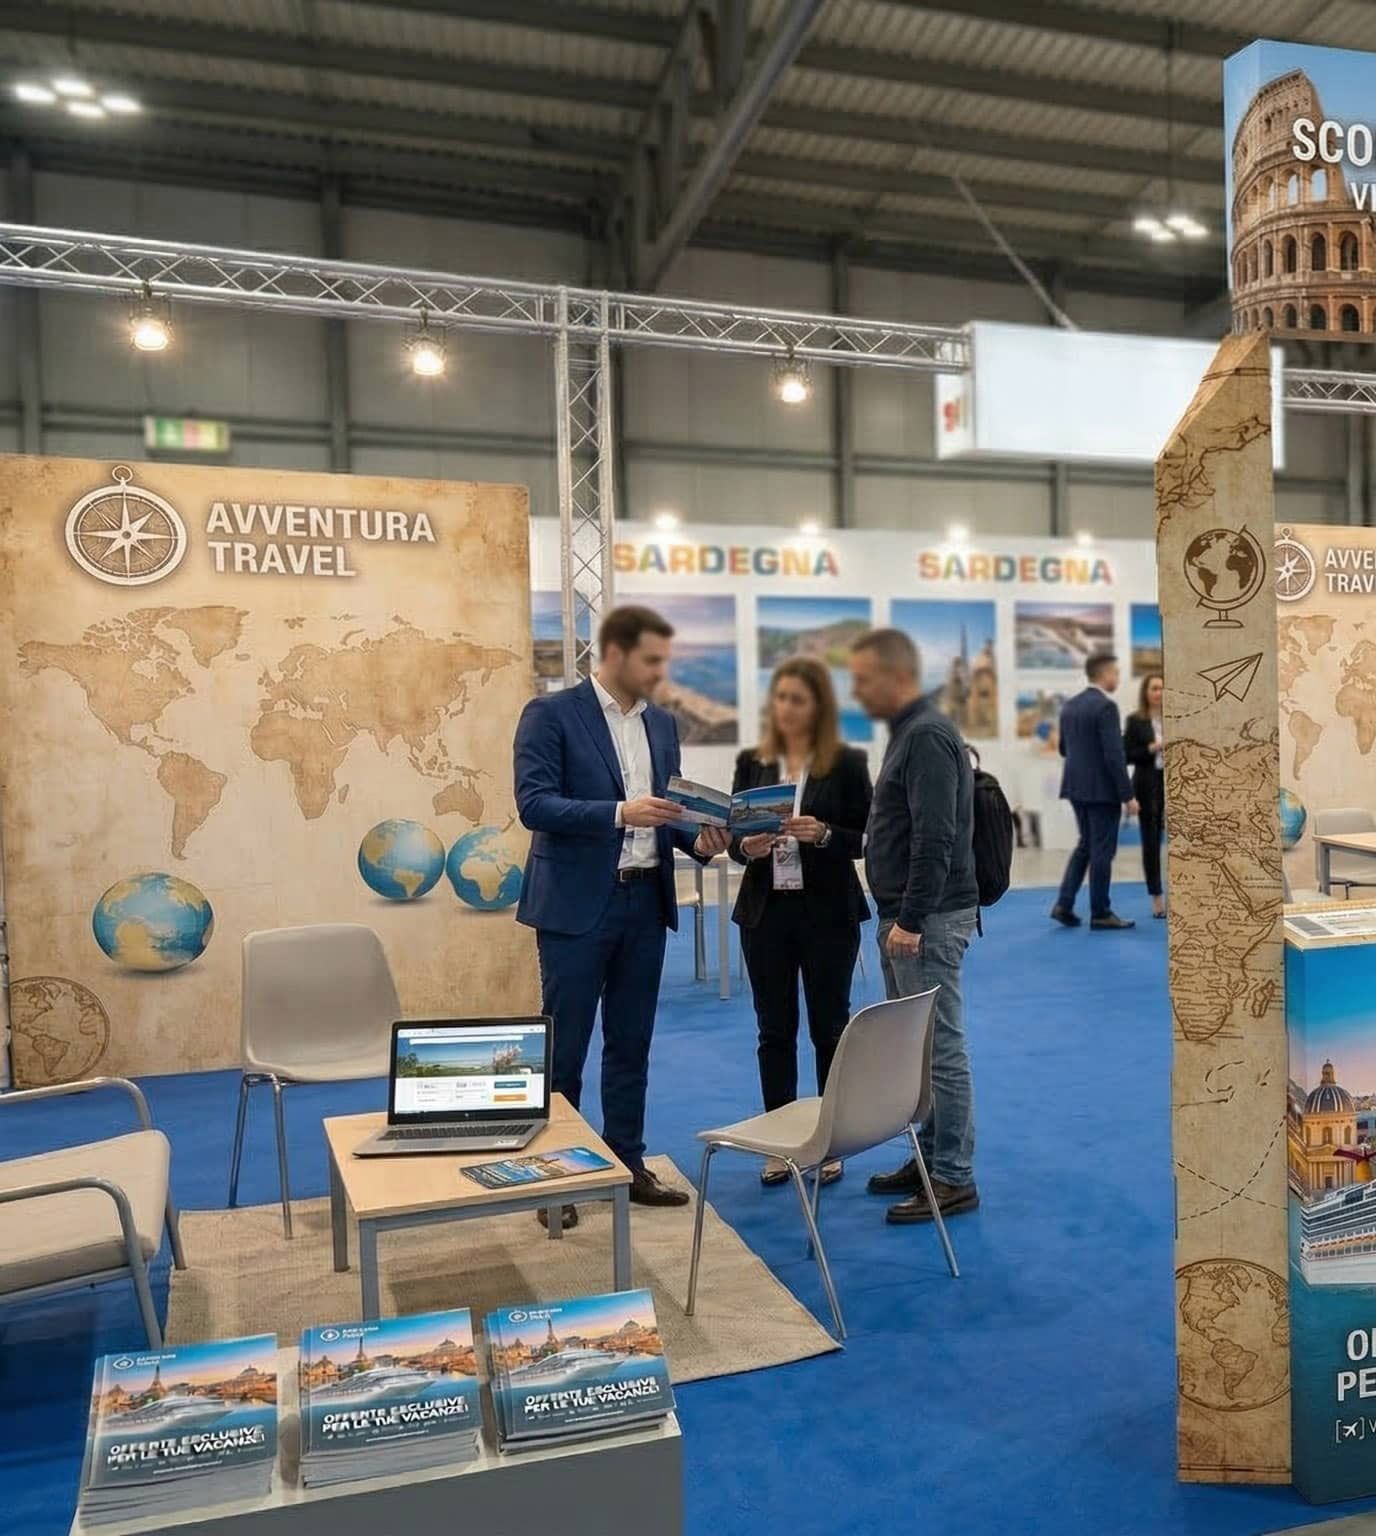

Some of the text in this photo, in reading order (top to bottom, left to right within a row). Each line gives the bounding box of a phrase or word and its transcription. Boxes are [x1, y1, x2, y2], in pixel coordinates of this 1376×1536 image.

[206, 502, 437, 544] AVVENTURA
[208, 541, 357, 577] TRAVEL
[613, 543, 839, 577] SARDEGNA
[918, 552, 1113, 585] SARDEGNA
